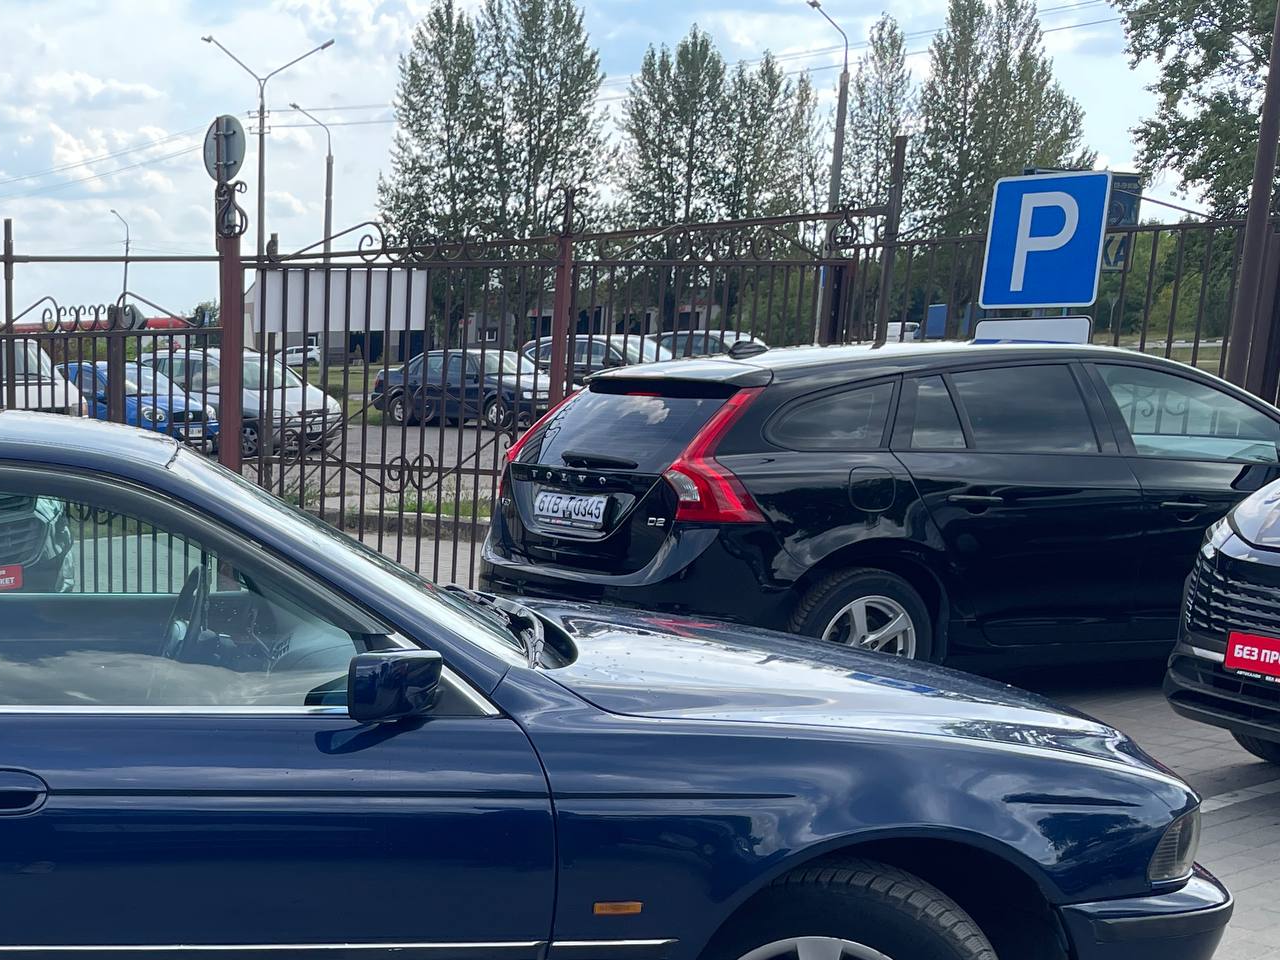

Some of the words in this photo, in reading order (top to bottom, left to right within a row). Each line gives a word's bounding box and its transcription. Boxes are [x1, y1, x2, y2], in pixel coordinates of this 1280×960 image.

[1009, 191, 1079, 291] P
[647, 517, 666, 527] D2
[1233, 644, 1259, 661] БЕЗ
[1260, 649, 1280, 665] ПР
